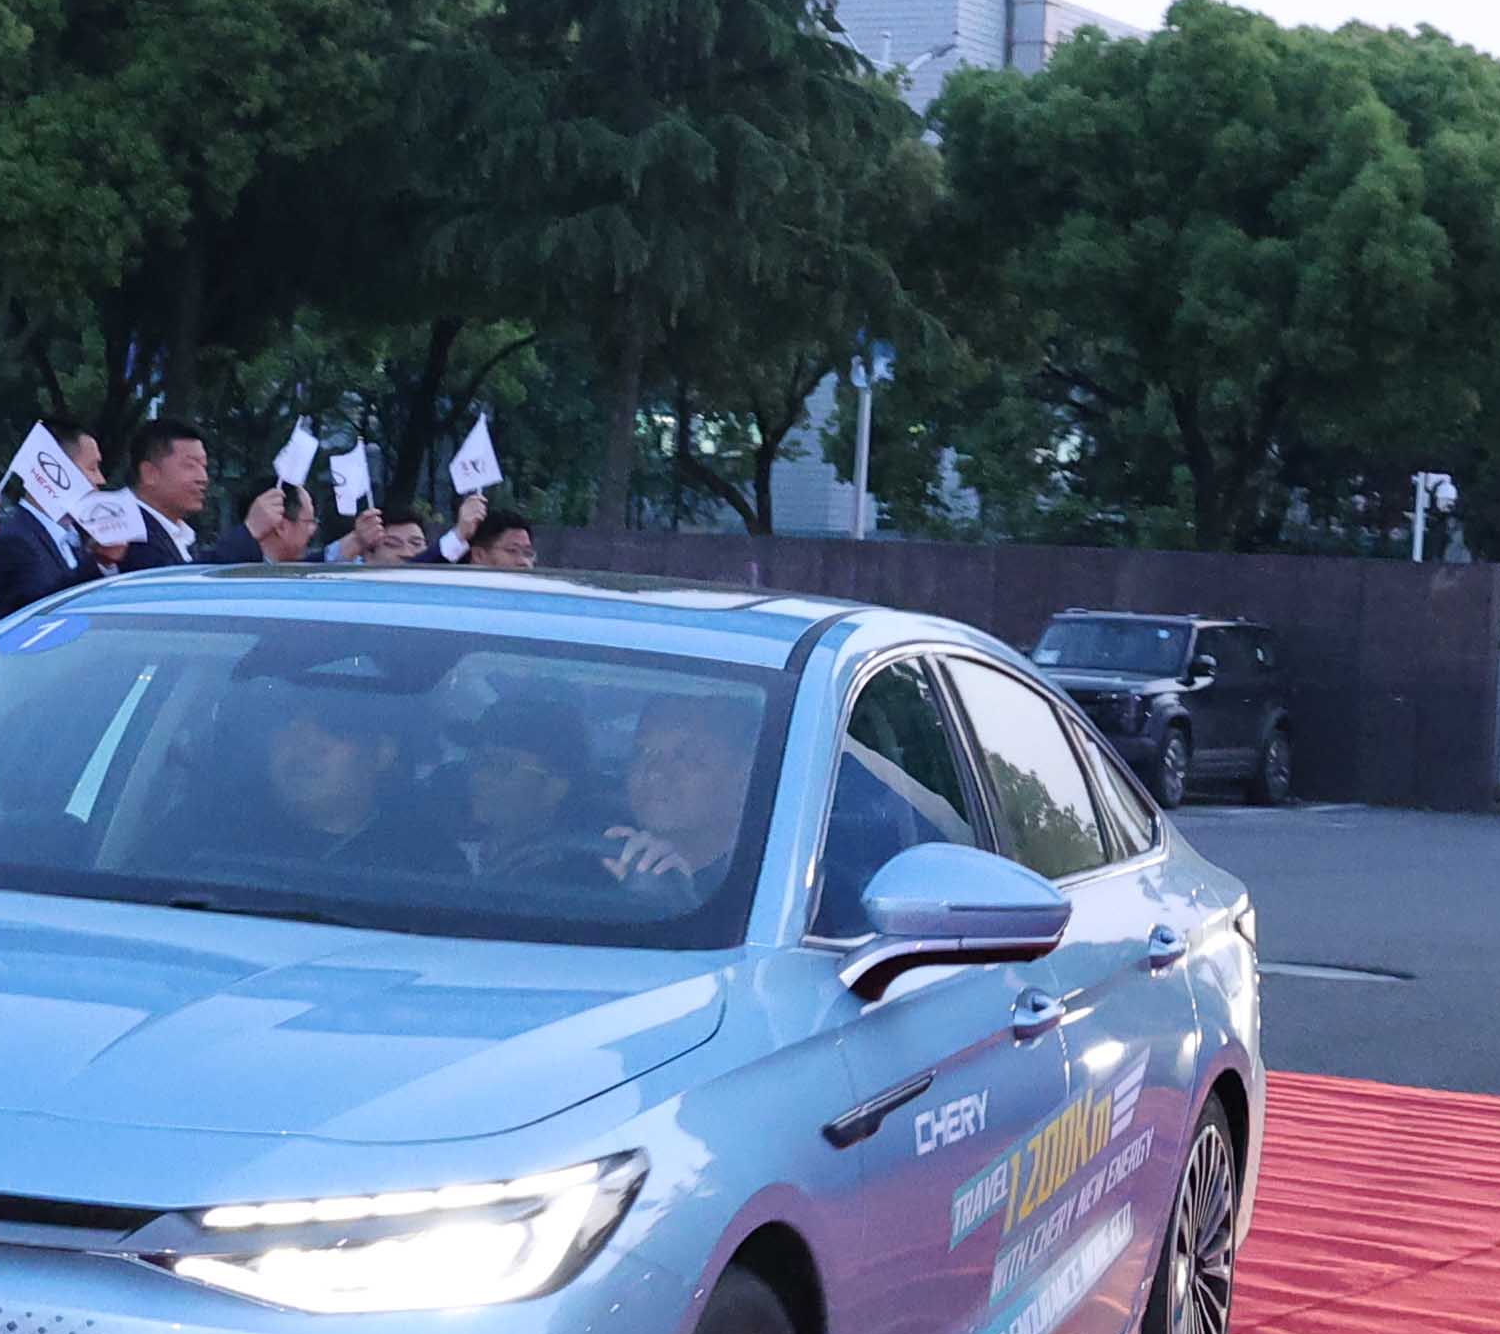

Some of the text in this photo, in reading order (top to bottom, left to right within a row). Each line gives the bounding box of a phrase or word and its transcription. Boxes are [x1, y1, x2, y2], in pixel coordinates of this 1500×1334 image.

[30, 467, 61, 500] HERY
[914, 1088, 991, 1157] CHERY
[953, 1160, 1010, 1241] TRAVEL
